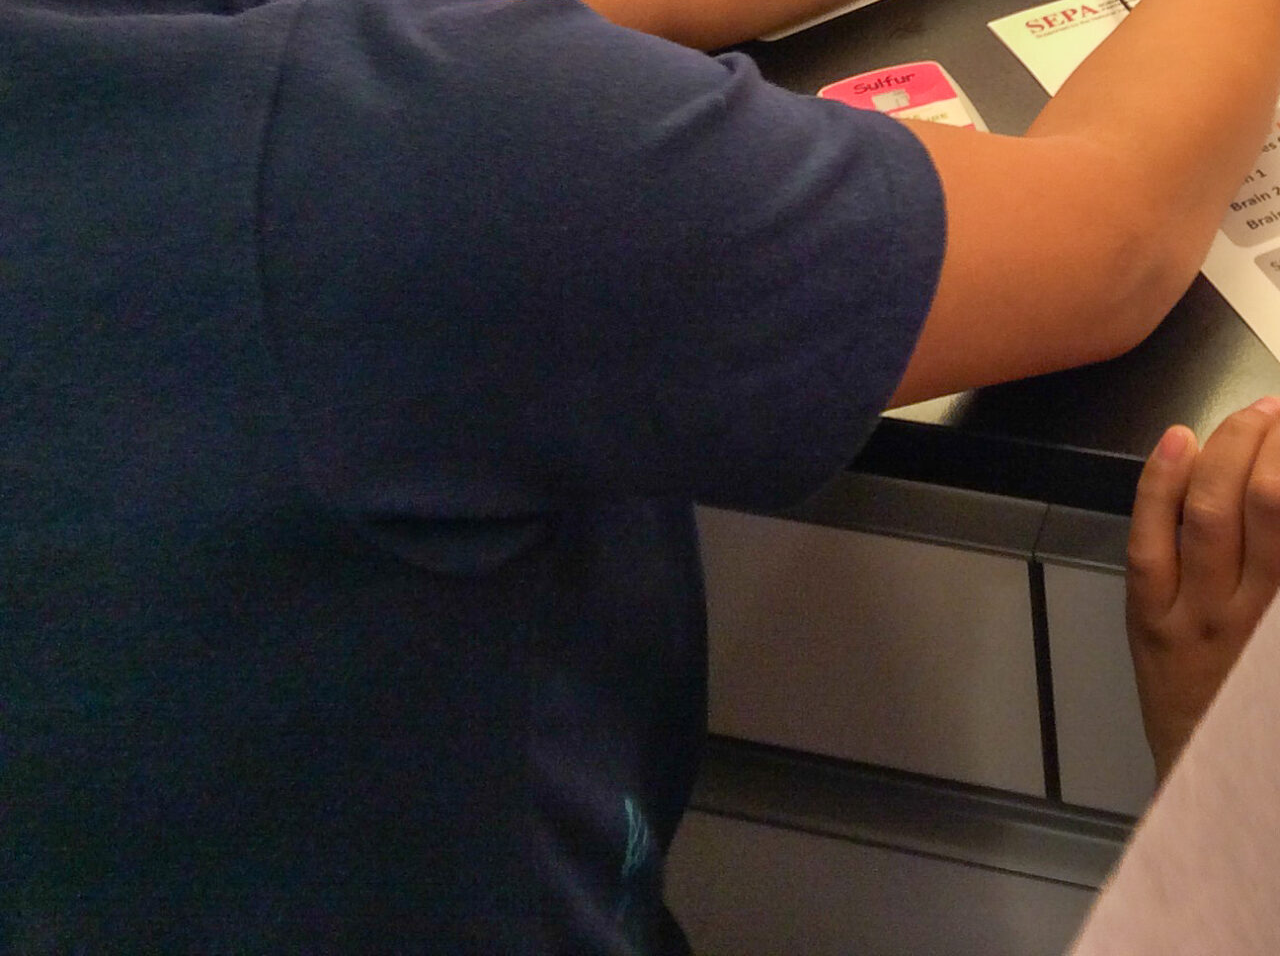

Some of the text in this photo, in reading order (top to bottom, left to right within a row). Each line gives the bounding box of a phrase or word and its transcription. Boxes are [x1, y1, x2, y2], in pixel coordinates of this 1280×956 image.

[1025, 4, 1098, 31] SEPA
[853, 73, 916, 95] Sulfur
[1229, 190, 1272, 212] Brain
